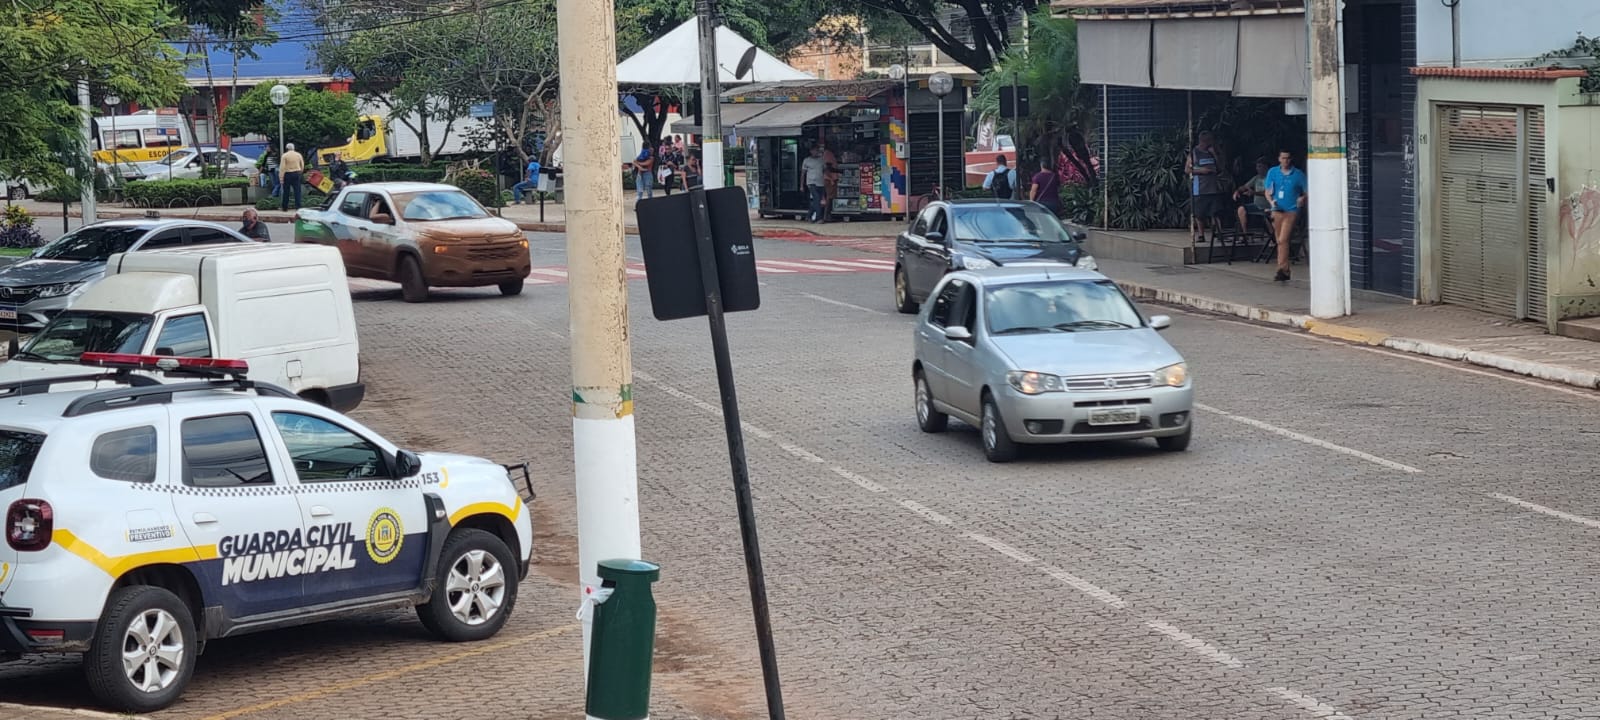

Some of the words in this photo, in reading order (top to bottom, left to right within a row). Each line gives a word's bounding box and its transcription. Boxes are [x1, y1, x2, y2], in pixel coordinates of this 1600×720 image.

[148, 150, 173, 158] ESCO
[421, 471, 440, 485] 153
[130, 530, 170, 541] PREVENTIVO
[218, 528, 302, 557] GUARDA
[306, 522, 355, 548] CIVIL
[221, 543, 357, 586] MUNICIPAL
